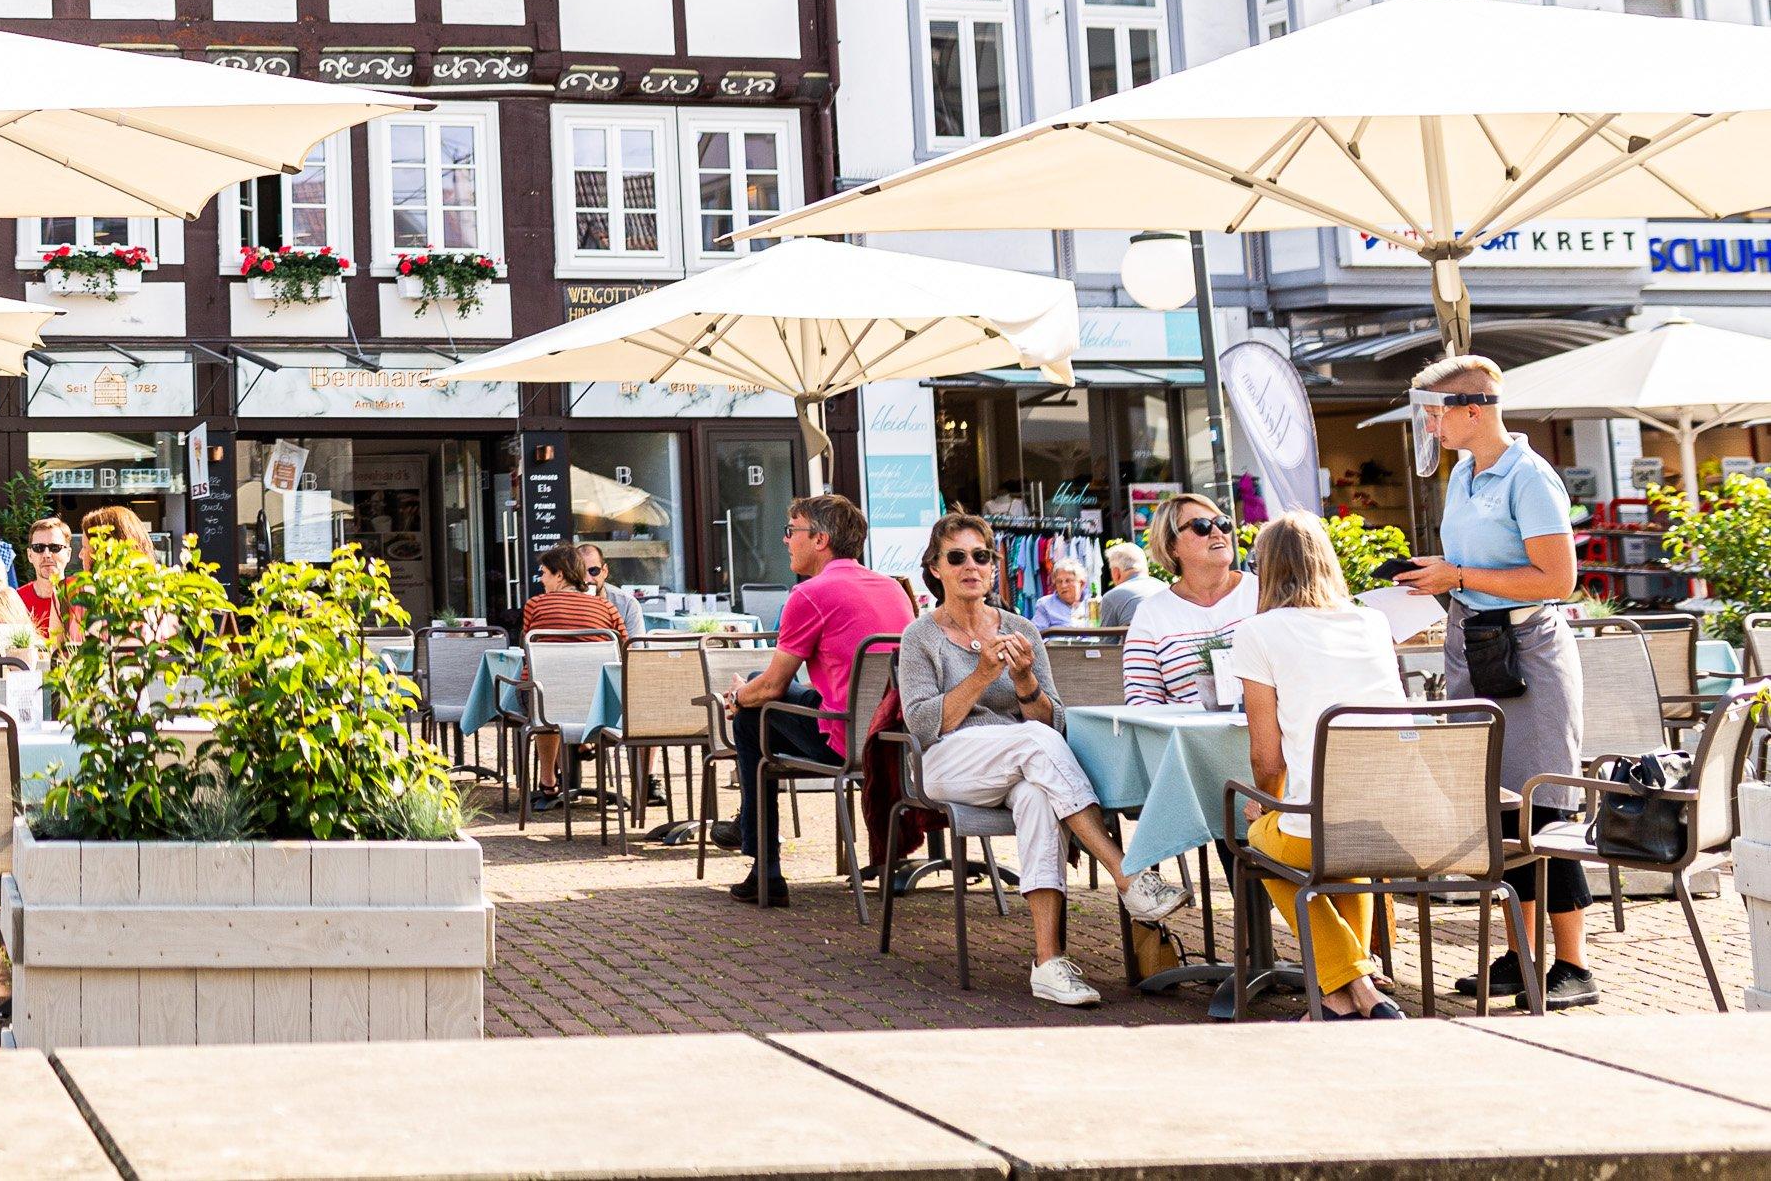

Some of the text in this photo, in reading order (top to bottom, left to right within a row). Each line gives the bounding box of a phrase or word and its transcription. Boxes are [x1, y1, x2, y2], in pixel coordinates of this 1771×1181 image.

[1533, 231, 1636, 251] KREFT
[66, 384, 158, 393] Seit 1782
[354, 399, 405, 409] Am Markt
[100, 468, 117, 489] B
[748, 465, 765, 486] B
[192, 482, 208, 497] EIS
[537, 483, 552, 493] Eis
